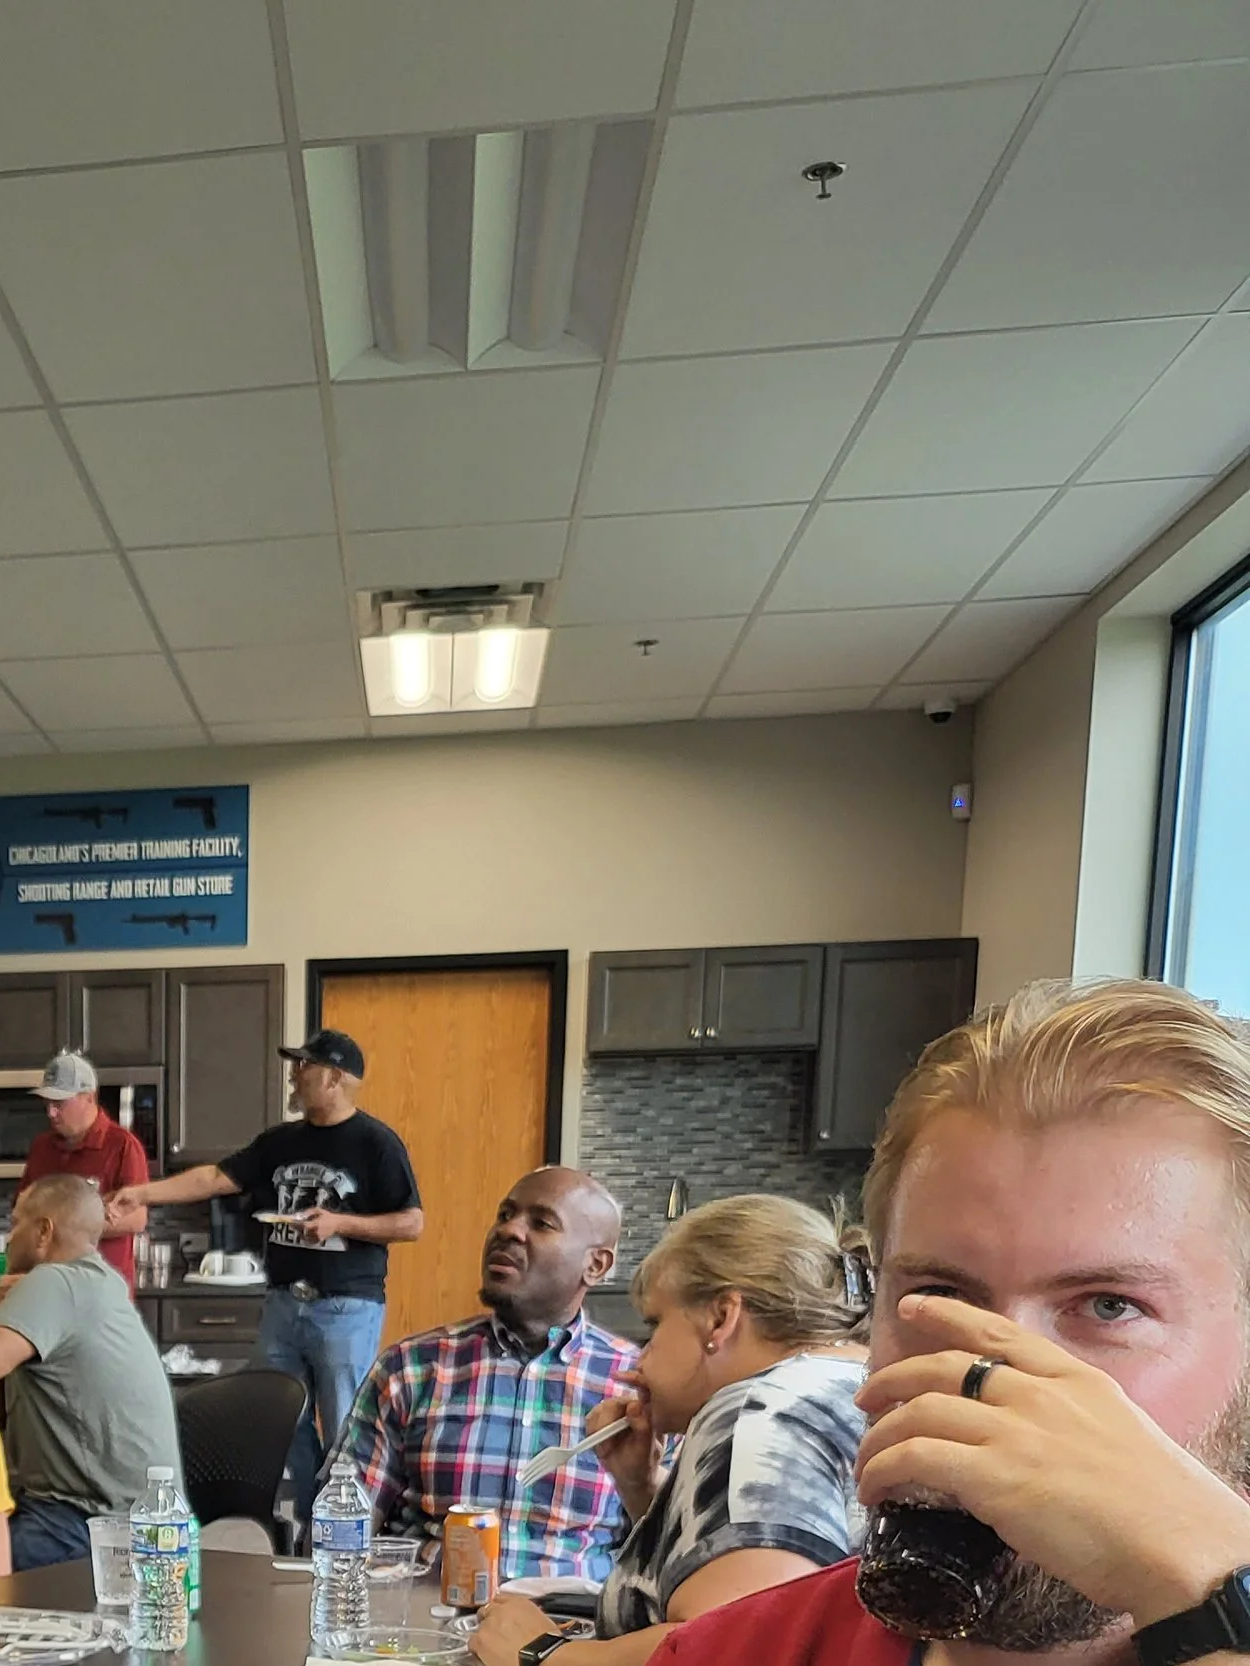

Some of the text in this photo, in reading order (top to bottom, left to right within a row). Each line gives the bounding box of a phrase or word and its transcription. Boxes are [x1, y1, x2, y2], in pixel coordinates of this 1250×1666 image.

[9, 836, 243, 866] CHICAGOLAND'S PREMIER TRAINING FACILITY,
[17, 875, 234, 903] SHOOTING RANGE AND RETAIL GUN STORE
